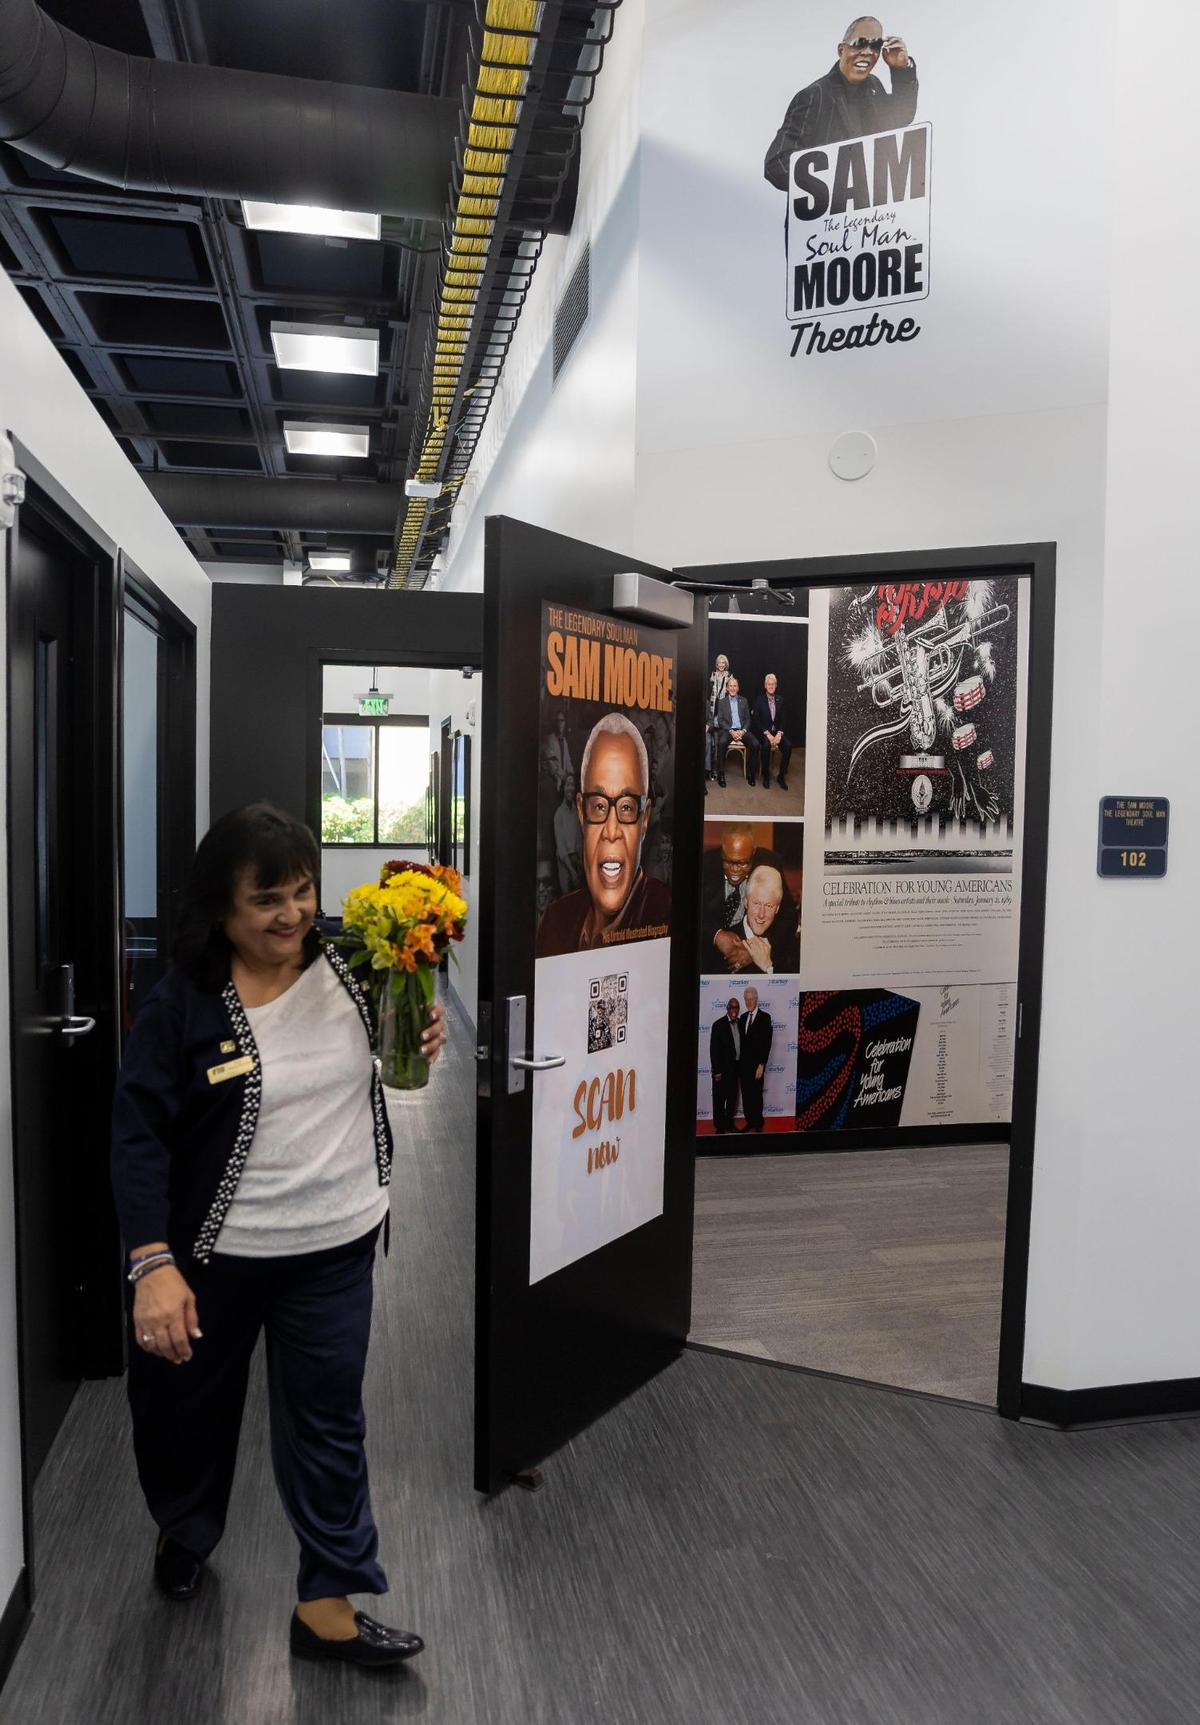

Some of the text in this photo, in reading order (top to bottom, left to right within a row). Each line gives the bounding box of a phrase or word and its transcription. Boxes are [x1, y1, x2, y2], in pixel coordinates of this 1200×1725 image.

[793, 127, 927, 221] SAM
[824, 210, 896, 232] The Legendary
[806, 224, 912, 262] Soul Man
[793, 243, 923, 312] MOORE
[790, 312, 921, 358] Theatre
[549, 608, 638, 646] THE LEGENDARY SOULMAN
[546, 631, 673, 712] SAM MOORE
[1121, 851, 1147, 867] 102
[823, 879, 1013, 895] CELEBRATION FOR YOUNG AMERICANS
[865, 1036, 912, 1059] Celebration
[860, 1073, 885, 1092] Young
[870, 1057, 885, 1078] for
[572, 1068, 636, 1139] SCAN
[853, 1086, 902, 1108] Americans
[587, 1136, 622, 1174] now
